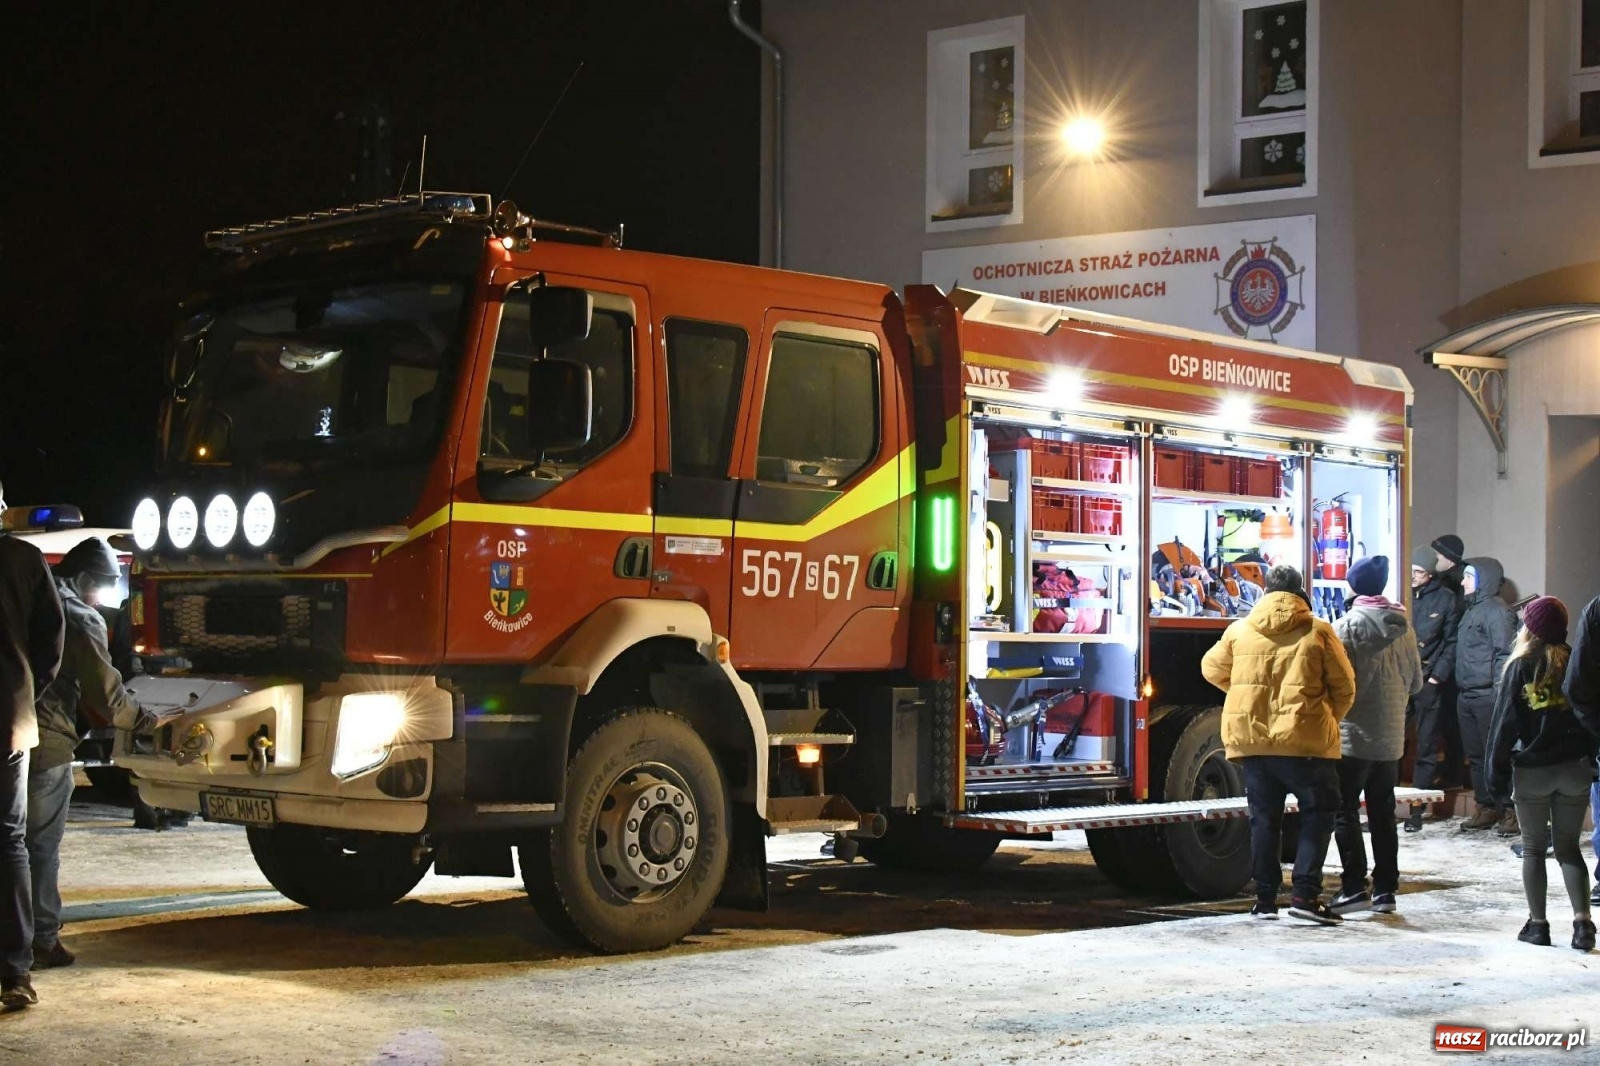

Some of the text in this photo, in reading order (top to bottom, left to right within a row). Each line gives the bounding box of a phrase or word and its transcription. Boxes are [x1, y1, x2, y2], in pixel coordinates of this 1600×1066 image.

[973, 246, 1220, 280] OCHOTNICZA STRAŻ POŻARNA
[1020, 281, 1166, 304] W BIEŃKOWICACH
[1169, 353, 1291, 392] OSP BIEŃKOWICE
[497, 540, 527, 558] OSP
[742, 549, 860, 601] 567 S 67
[323, 581, 340, 594] FL
[484, 610, 533, 633] Bieńkowice
[1052, 656, 1075, 667] WISS
[209, 796, 270, 820] SRC MM15
